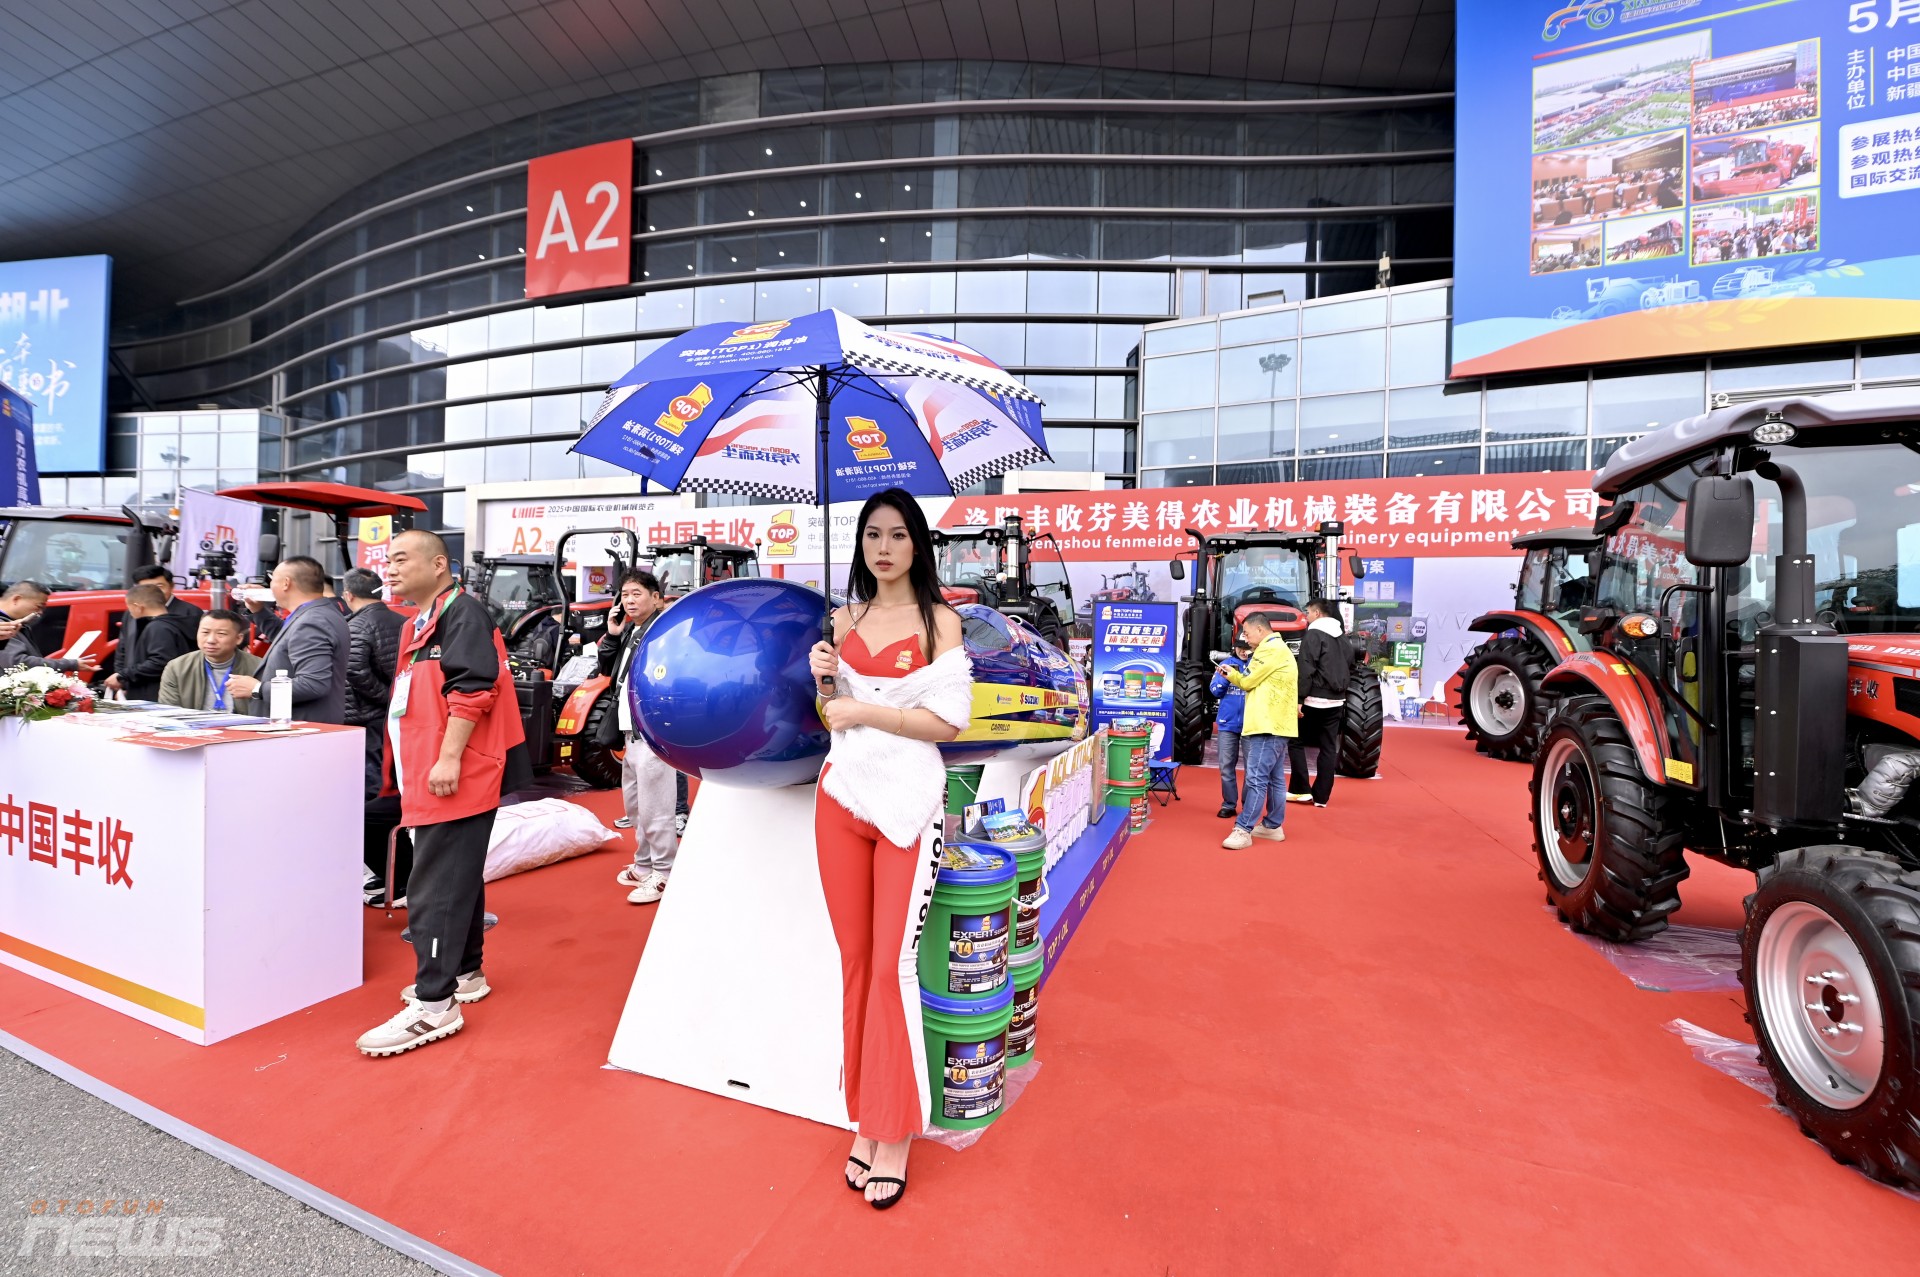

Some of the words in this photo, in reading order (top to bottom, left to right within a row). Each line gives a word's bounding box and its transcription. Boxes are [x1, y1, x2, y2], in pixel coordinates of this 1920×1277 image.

[1847, 49, 1866, 111] 主办单位
[535, 180, 620, 260] A2
[512, 526, 542, 553] A2
[648, 518, 756, 548] 中国丰收
[770, 528, 794, 540] TOP
[1106, 532, 1183, 548] fenmeide
[1405, 526, 1520, 548] equipment
[590, 575, 605, 583] TOP
[1025, 694, 1039, 705] SUZUKI
[0, 793, 134, 890] 中国丰收
[930, 819, 943, 880] TOP
[923, 885, 932, 897] 1
[912, 903, 929, 950] OIL
[953, 929, 995, 939] EXPERT
[956, 941, 973, 954] T4
[948, 1056, 990, 1066] EXPERT
[951, 1068, 967, 1081] T4
